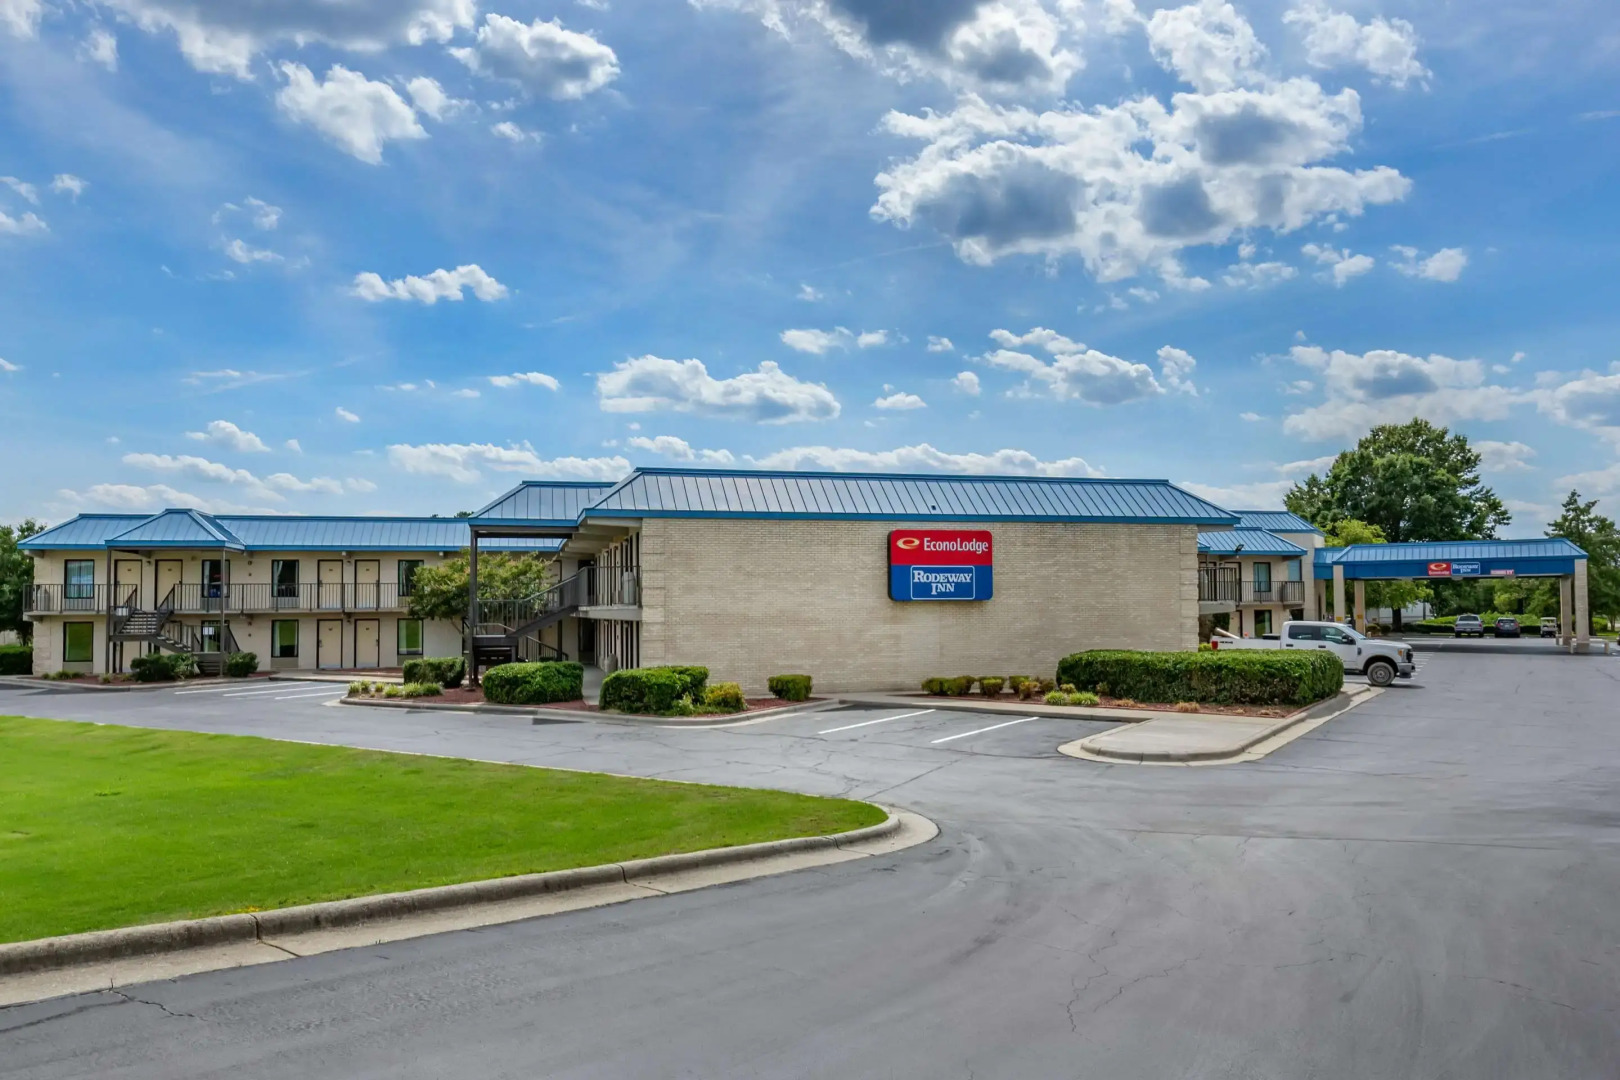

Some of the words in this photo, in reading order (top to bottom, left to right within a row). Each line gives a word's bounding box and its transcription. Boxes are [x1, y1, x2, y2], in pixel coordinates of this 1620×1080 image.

[924, 538, 988, 554] EconoLodge
[913, 570, 972, 583] RODEWAY
[930, 583, 955, 595] INN
